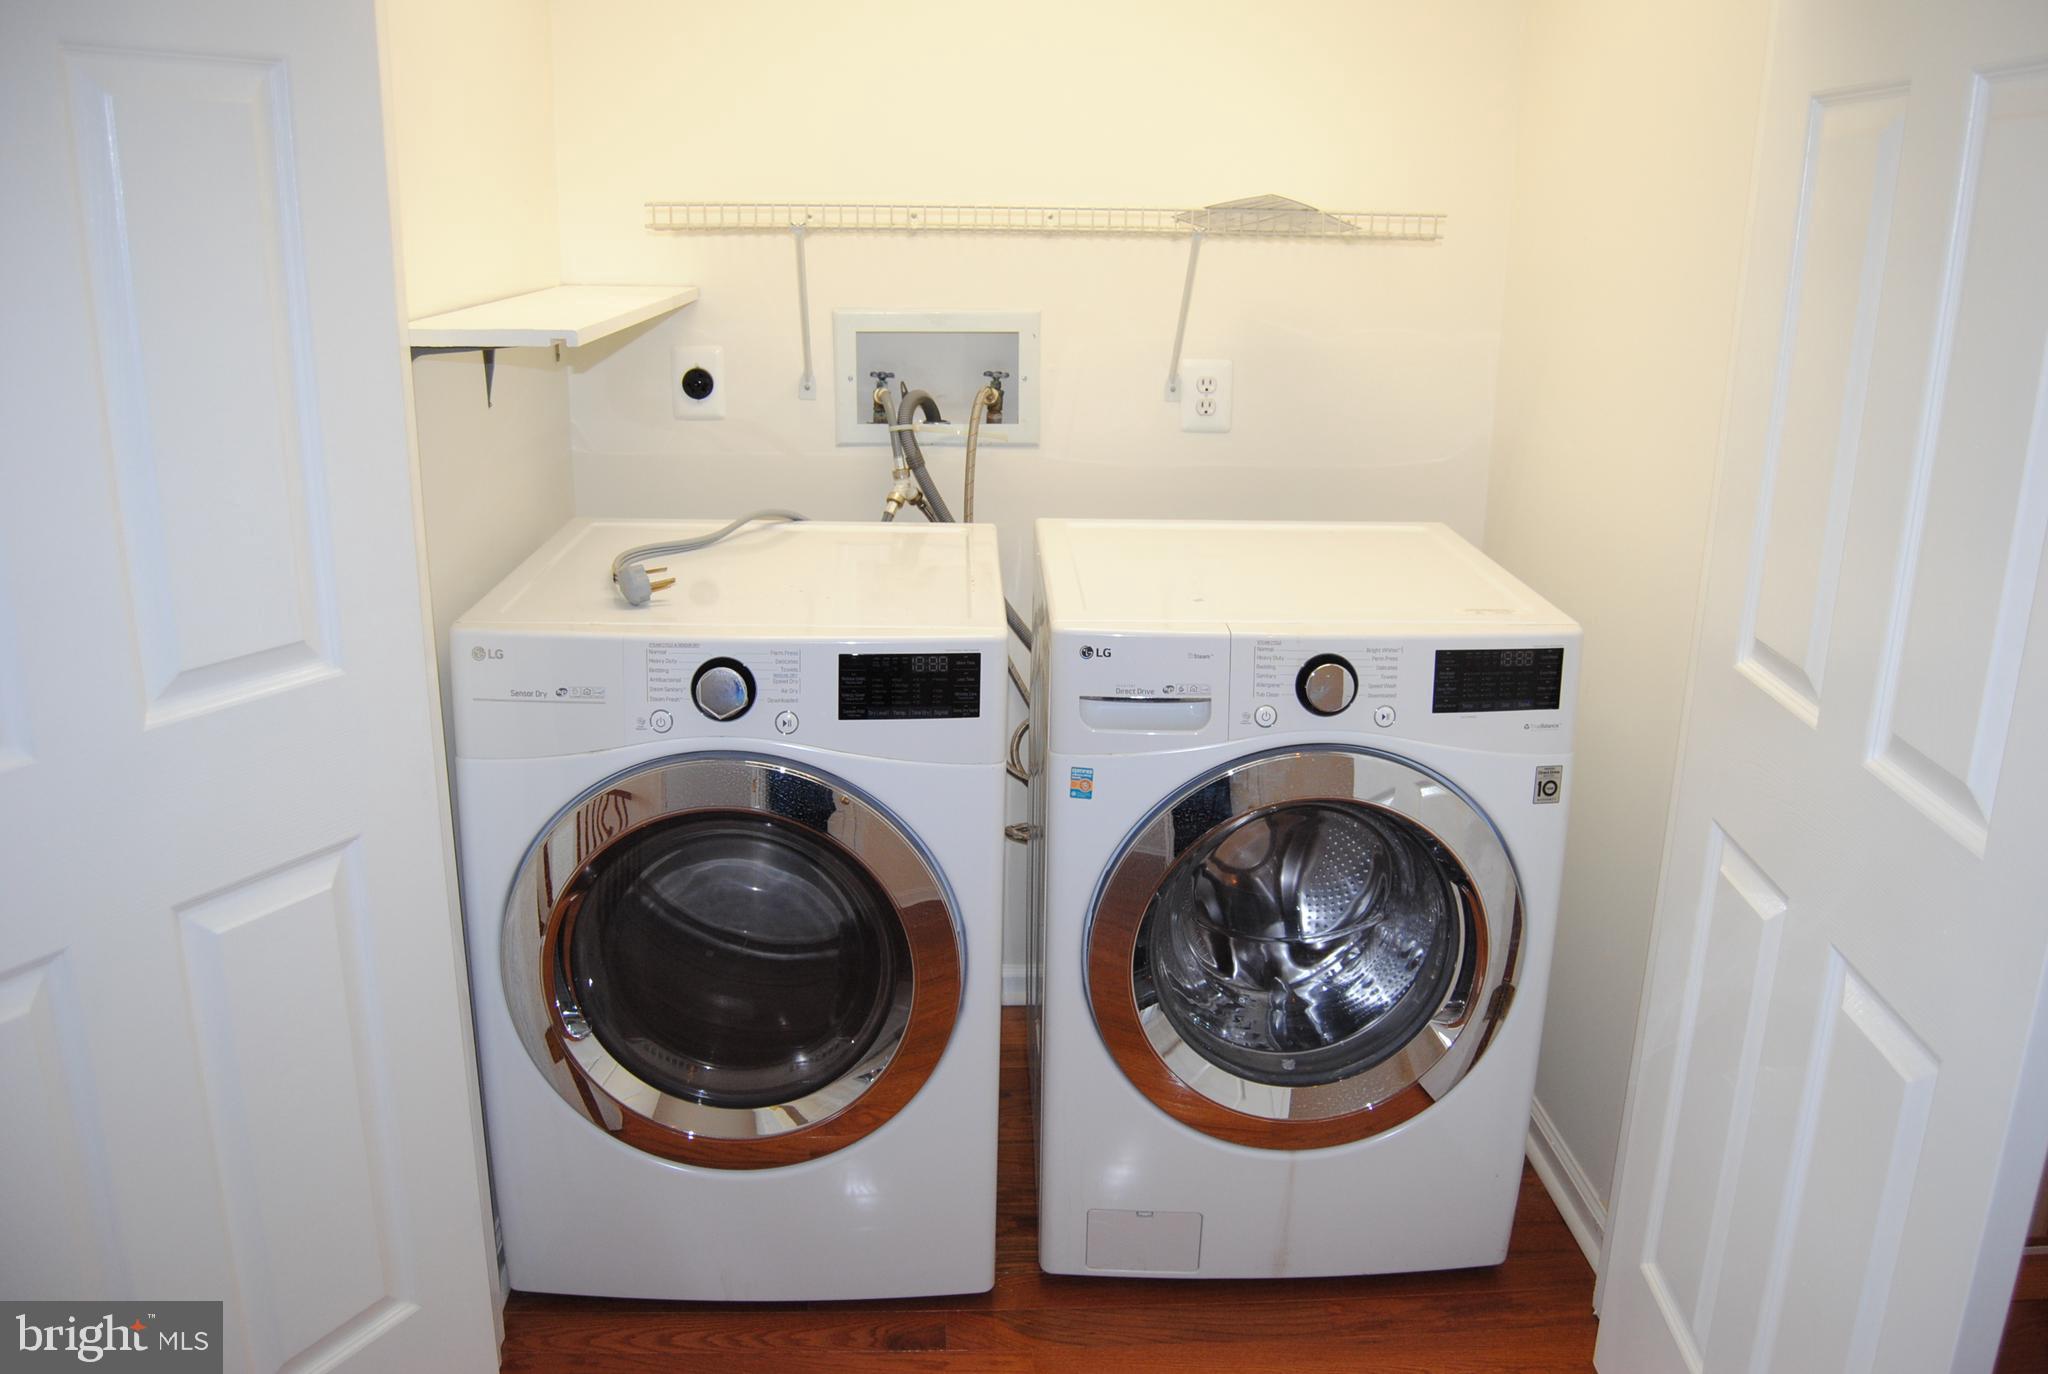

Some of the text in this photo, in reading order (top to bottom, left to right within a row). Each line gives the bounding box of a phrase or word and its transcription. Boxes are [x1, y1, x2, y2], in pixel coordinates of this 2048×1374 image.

[488, 649, 504, 660] LG
[1096, 648, 1112, 658] LG
[510, 689, 533, 697] Sensor
[536, 690, 547, 699] Dry
[1115, 687, 1136, 695] Direct
[1137, 688, 1155, 696] Drive
